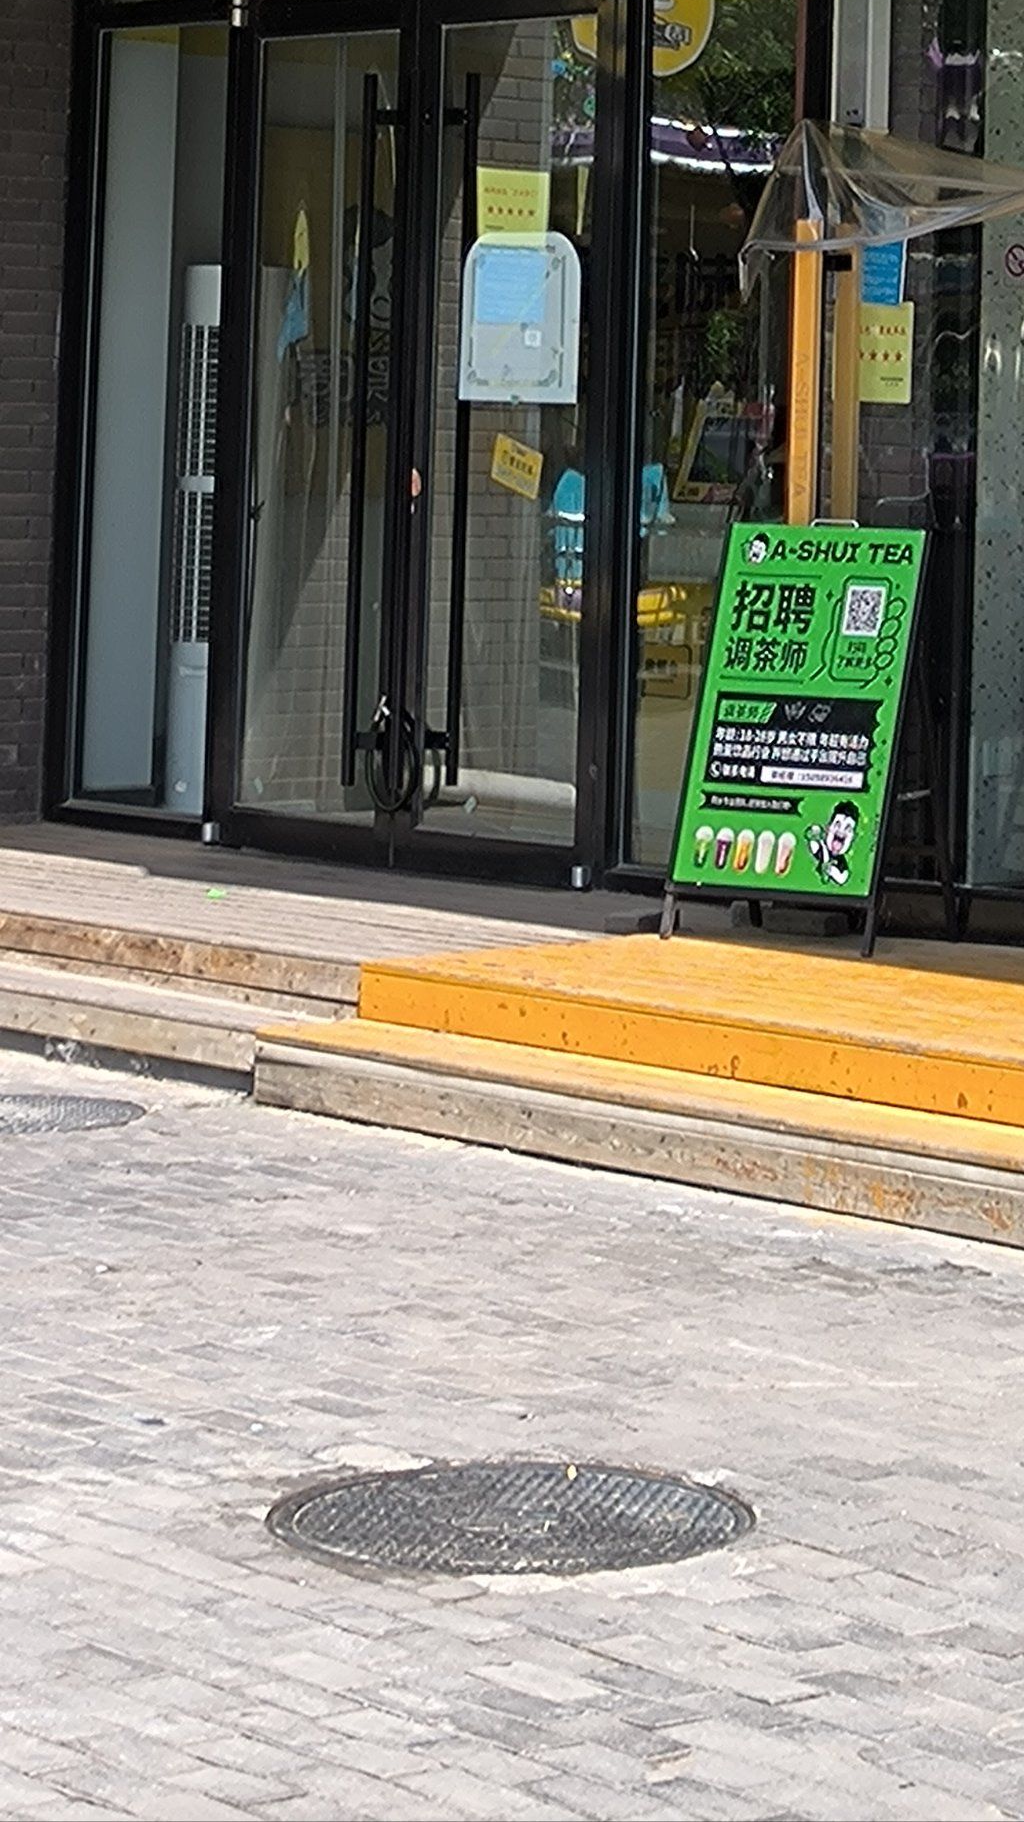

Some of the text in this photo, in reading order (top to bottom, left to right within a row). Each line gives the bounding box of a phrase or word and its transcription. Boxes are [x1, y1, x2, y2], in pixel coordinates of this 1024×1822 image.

[770, 539, 914, 565] A-SHUI TEA
[731, 580, 817, 633] 招聘
[724, 636, 810, 674] 调茶师
